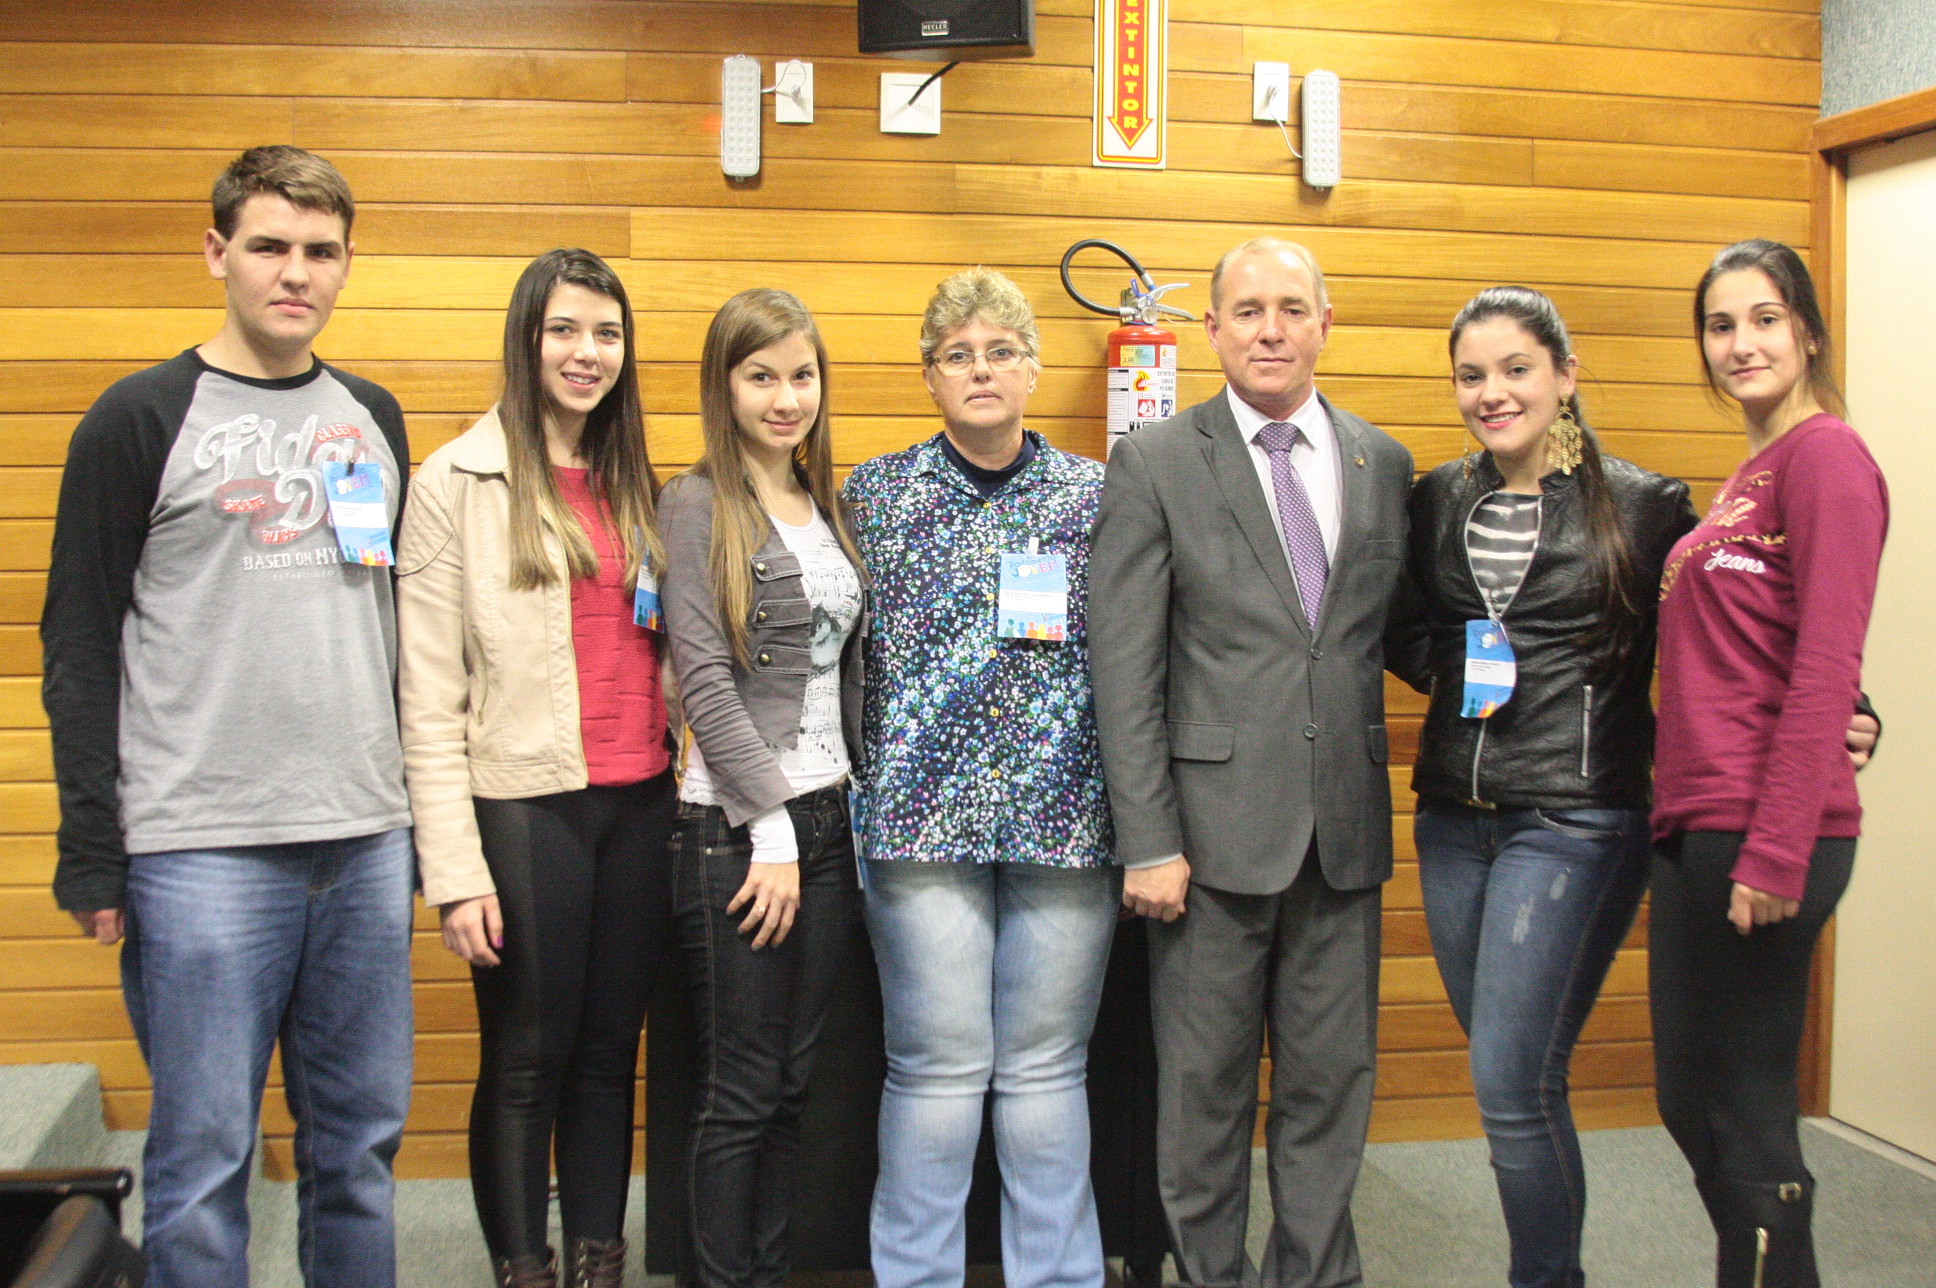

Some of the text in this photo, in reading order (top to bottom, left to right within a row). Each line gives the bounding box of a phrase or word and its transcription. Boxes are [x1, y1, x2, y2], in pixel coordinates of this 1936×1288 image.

[1122, 0, 1139, 129] EXTINTOR
[243, 547, 338, 571] BASED ON MY
[1704, 548, 1766, 574] Jeans
